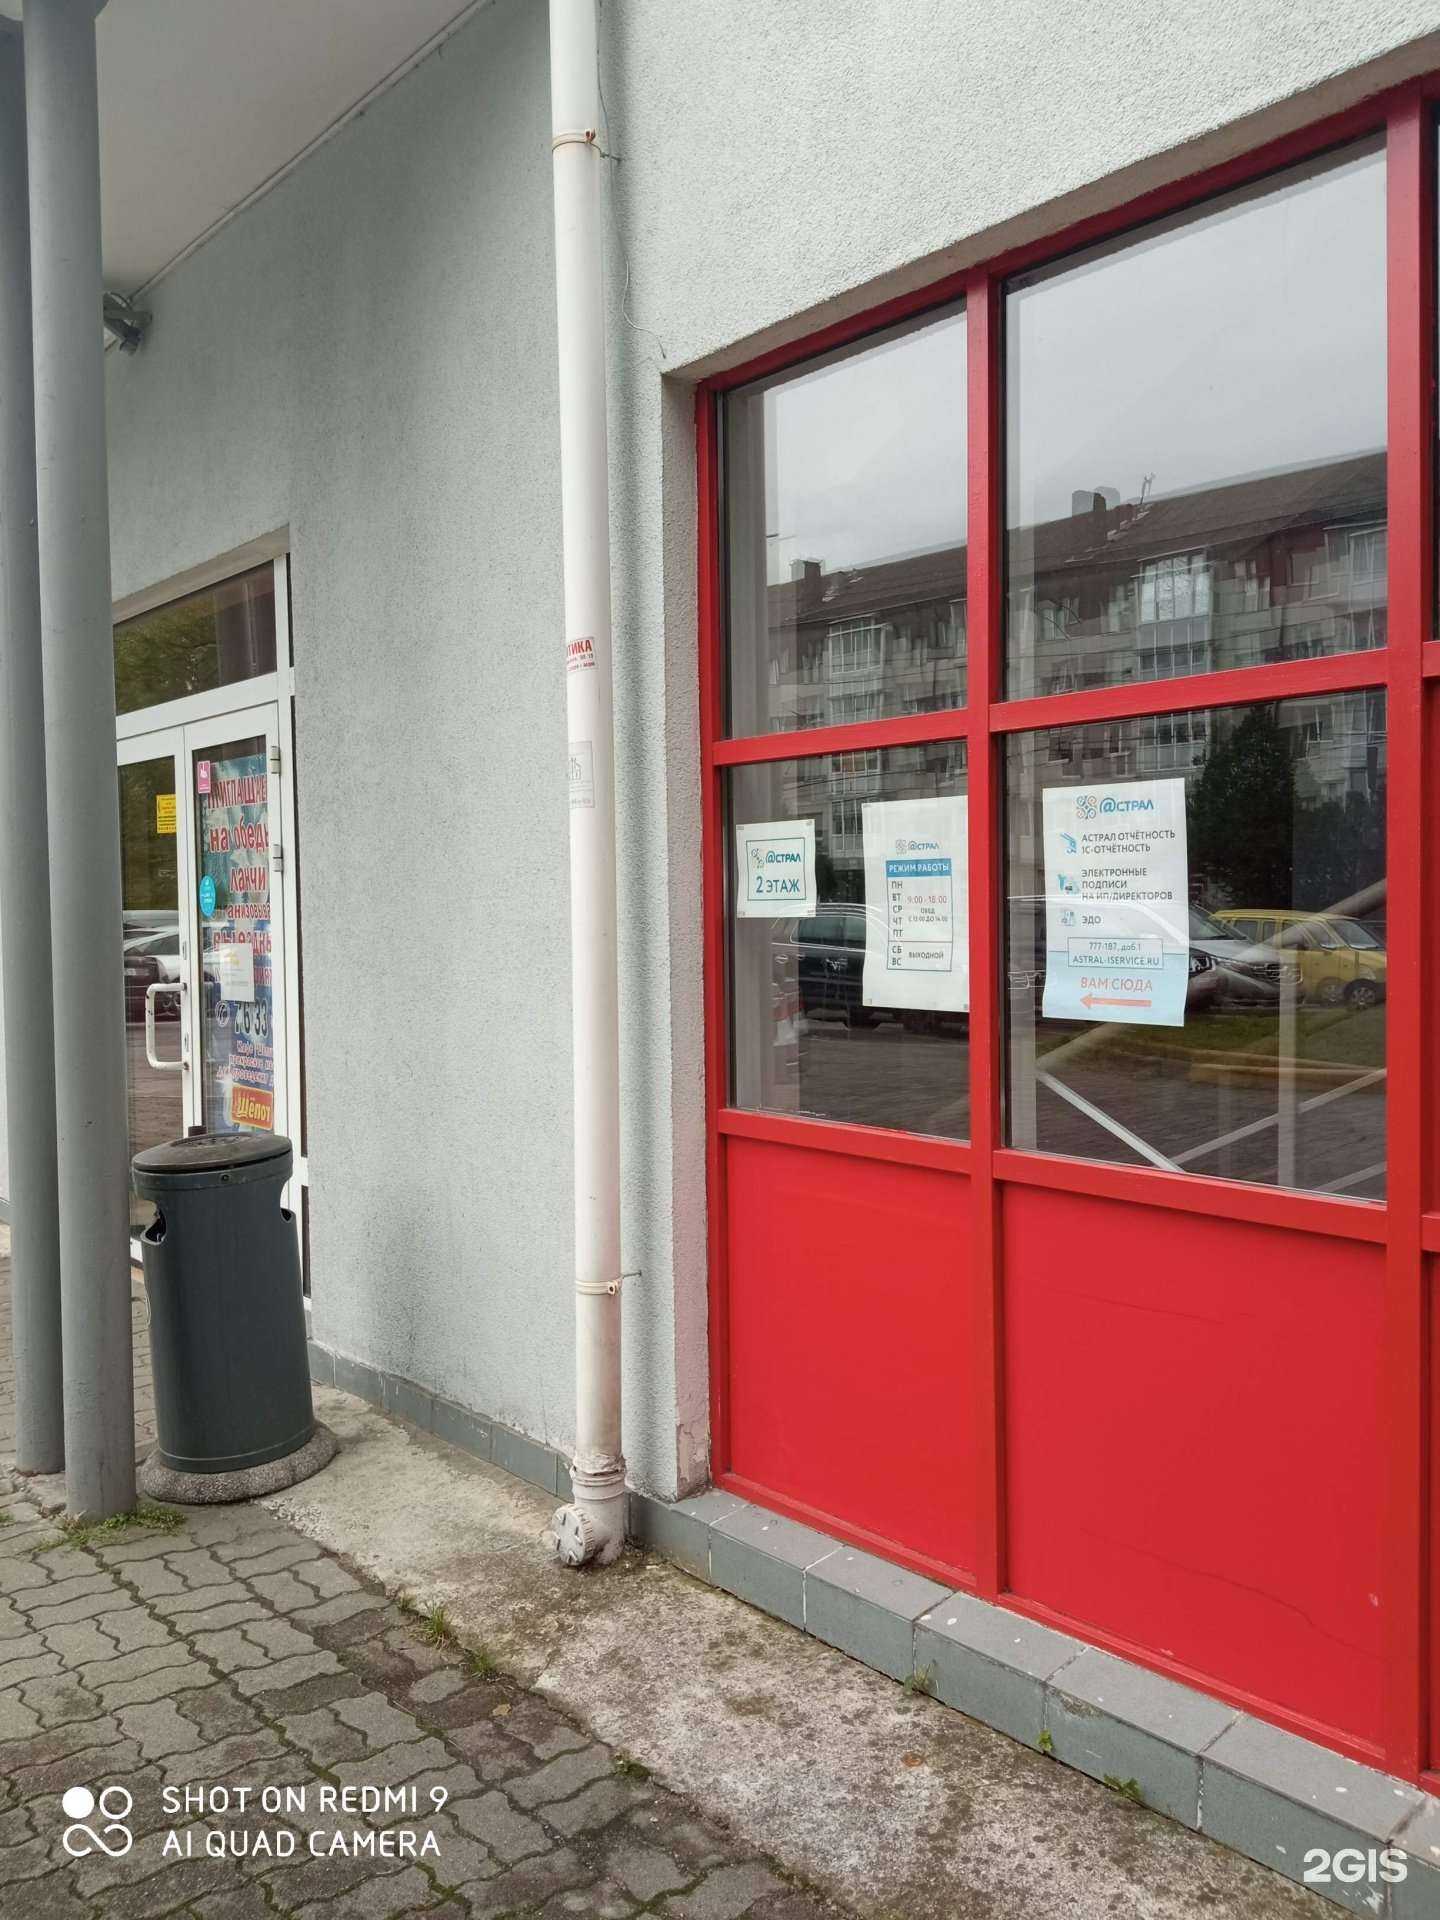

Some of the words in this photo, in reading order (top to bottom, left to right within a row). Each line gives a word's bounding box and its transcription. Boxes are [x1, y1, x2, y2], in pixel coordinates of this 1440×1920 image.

[1081, 833, 1116, 842] АСТРАЛ
[1117, 829, 1176, 841] ОТЧЁТНОСТЬ
[1081, 843, 1151, 854] 1С-ОТЧЁТНОСТЬ
[888, 864, 917, 873] РЕЖИМ
[918, 863, 949, 872] РАБОТЫ
[1081, 867, 1147, 878] ЭЛЕКТРОННЫЕ
[756, 875, 763, 893] 2
[766, 877, 800, 893] ЭТАЖ
[891, 880, 903, 889] ПН
[1081, 880, 1128, 890] ПОДПИСИ
[892, 892, 902, 901] ВТ
[1082, 892, 1094, 901] НА
[1096, 891, 1173, 901] ИП/ДИРЕКТОРОВ
[893, 904, 903, 913] СР
[892, 916, 902, 925] ЧТ
[1081, 915, 1102, 925] ЭДО
[893, 928, 904, 938] ПТ
[892, 945, 902, 954] СБ
[908, 951, 944, 960] ВЫХОДНОЙ
[1072, 955, 1160, 966] ASTRAL-ISERVICE.RU
[892, 957, 902, 966] ВС
[1080, 976, 1109, 990] ВАМ
[1111, 977, 1153, 993] СЮДА
